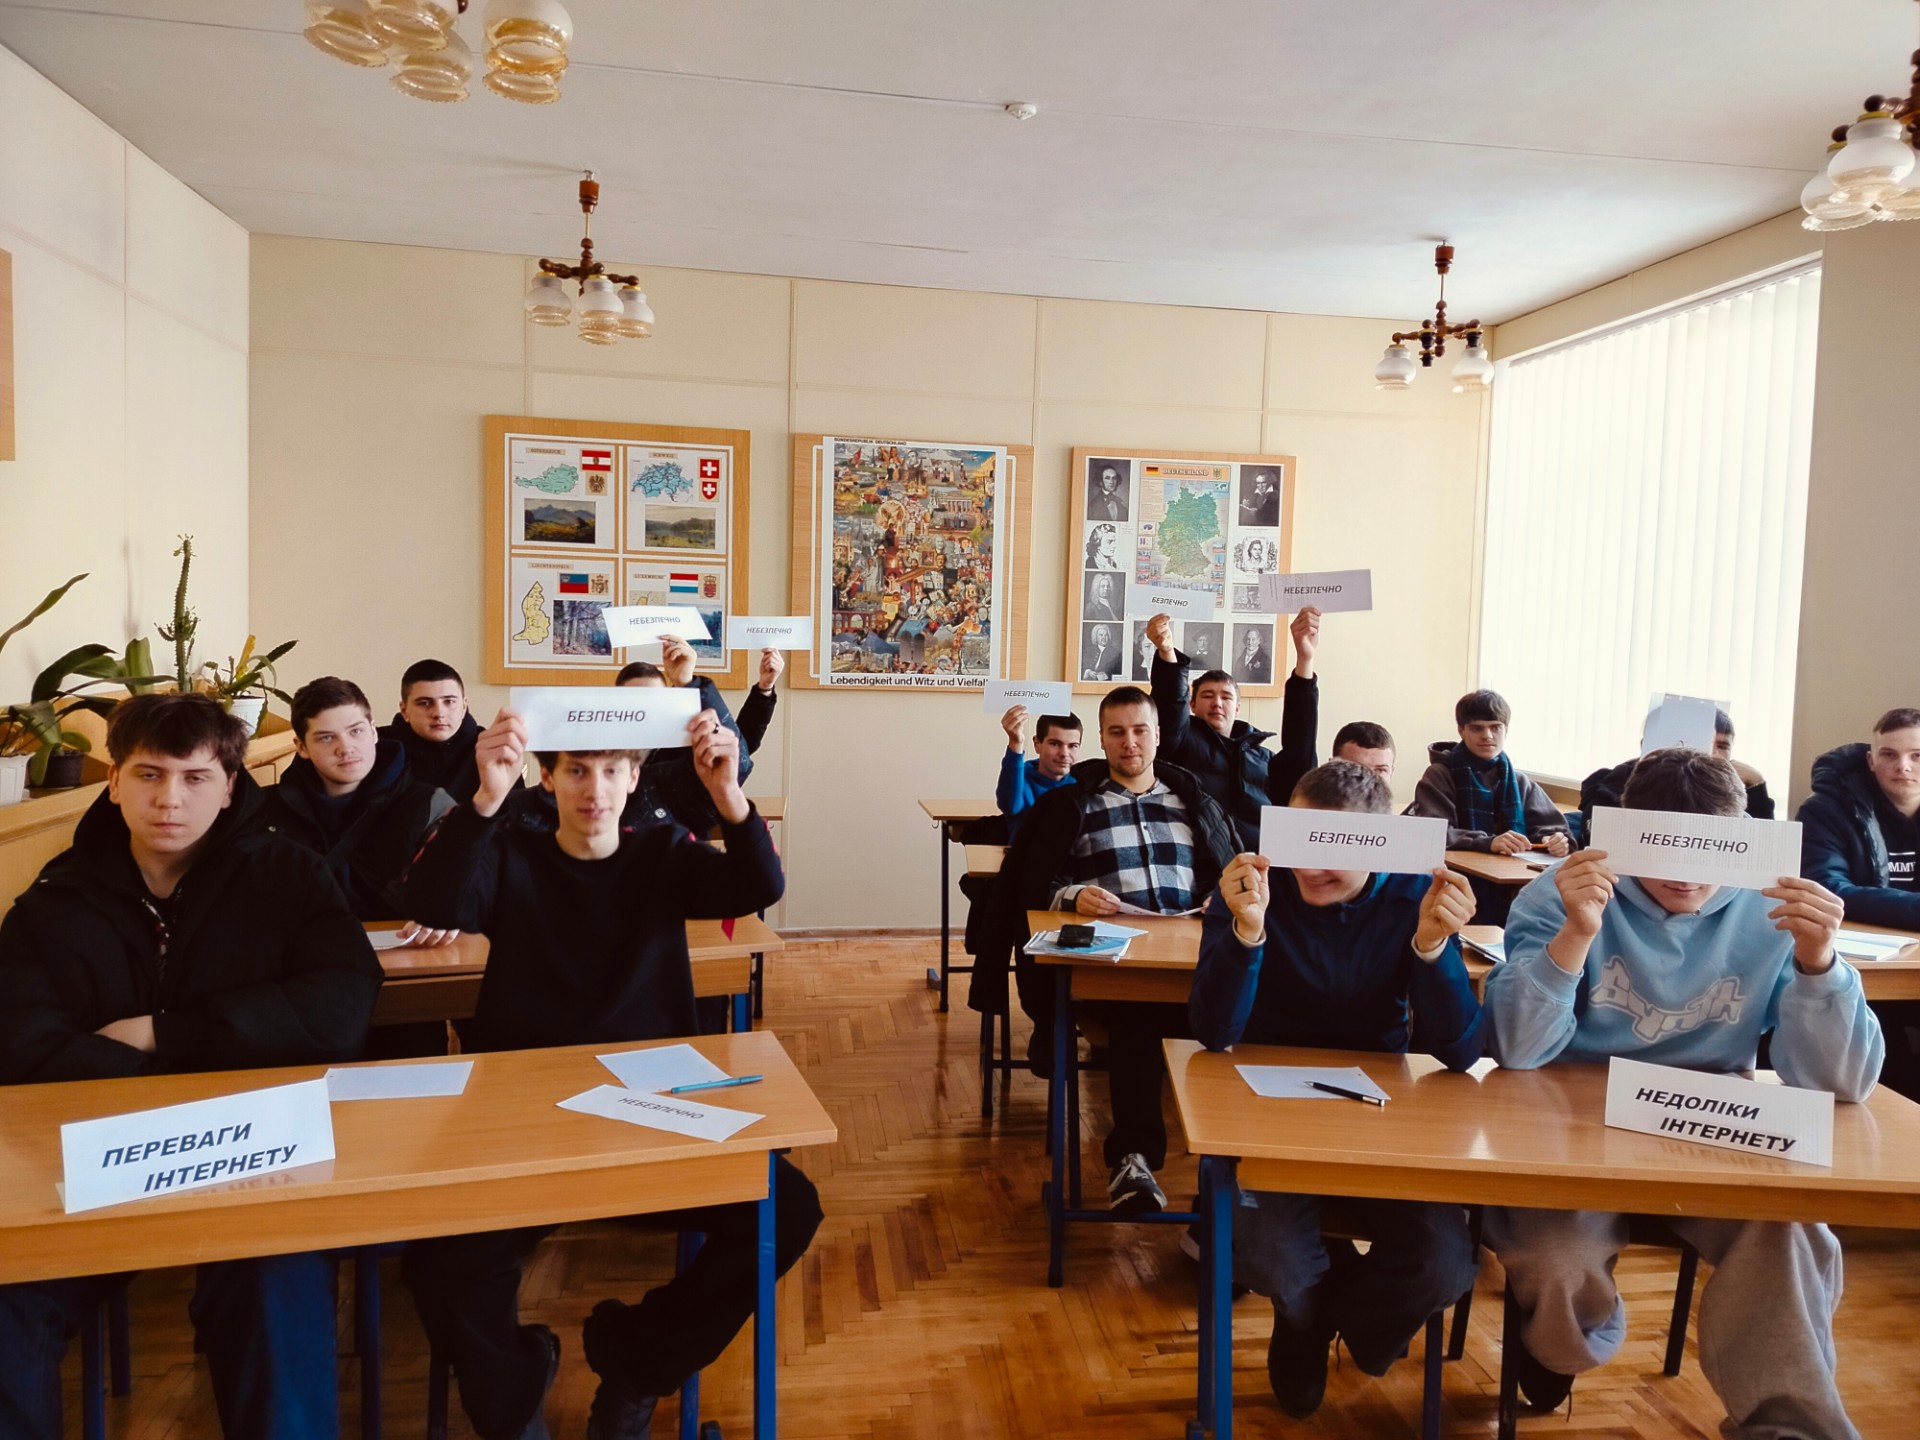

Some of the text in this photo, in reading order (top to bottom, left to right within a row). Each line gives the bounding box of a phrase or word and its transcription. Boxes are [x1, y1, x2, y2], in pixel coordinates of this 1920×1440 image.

[1162, 468, 1209, 476] DEUTSCHLAND
[1284, 584, 1342, 595] НЕБЕЗПЕЧНО
[1151, 596, 1188, 607] БЕЗПЕЧНО
[629, 616, 681, 626] НЕБЕЗПЕЧНО
[746, 627, 793, 635] НЕБЕЗПЕЧНО
[830, 676, 989, 687] Lebendigkeit und Witz und Vielfal
[1004, 690, 1050, 699] НЕБЕЗПЕЧНО
[567, 710, 646, 723] БЕЗПЕЧНО
[1308, 831, 1387, 847] БЕЗПЕЧНО
[1639, 832, 1749, 854] НЕБЕЗПЕЧНО
[617, 1097, 705, 1119] НЕБЕЗПЕЧНО
[1635, 1087, 1761, 1121] НЕДОЛІКИ
[1659, 1116, 1797, 1153] ІНТЕРНЕТУ
[101, 1122, 253, 1168] ПЕРЕВАГИ
[143, 1144, 298, 1192] ІНТЕРНЕТУ
